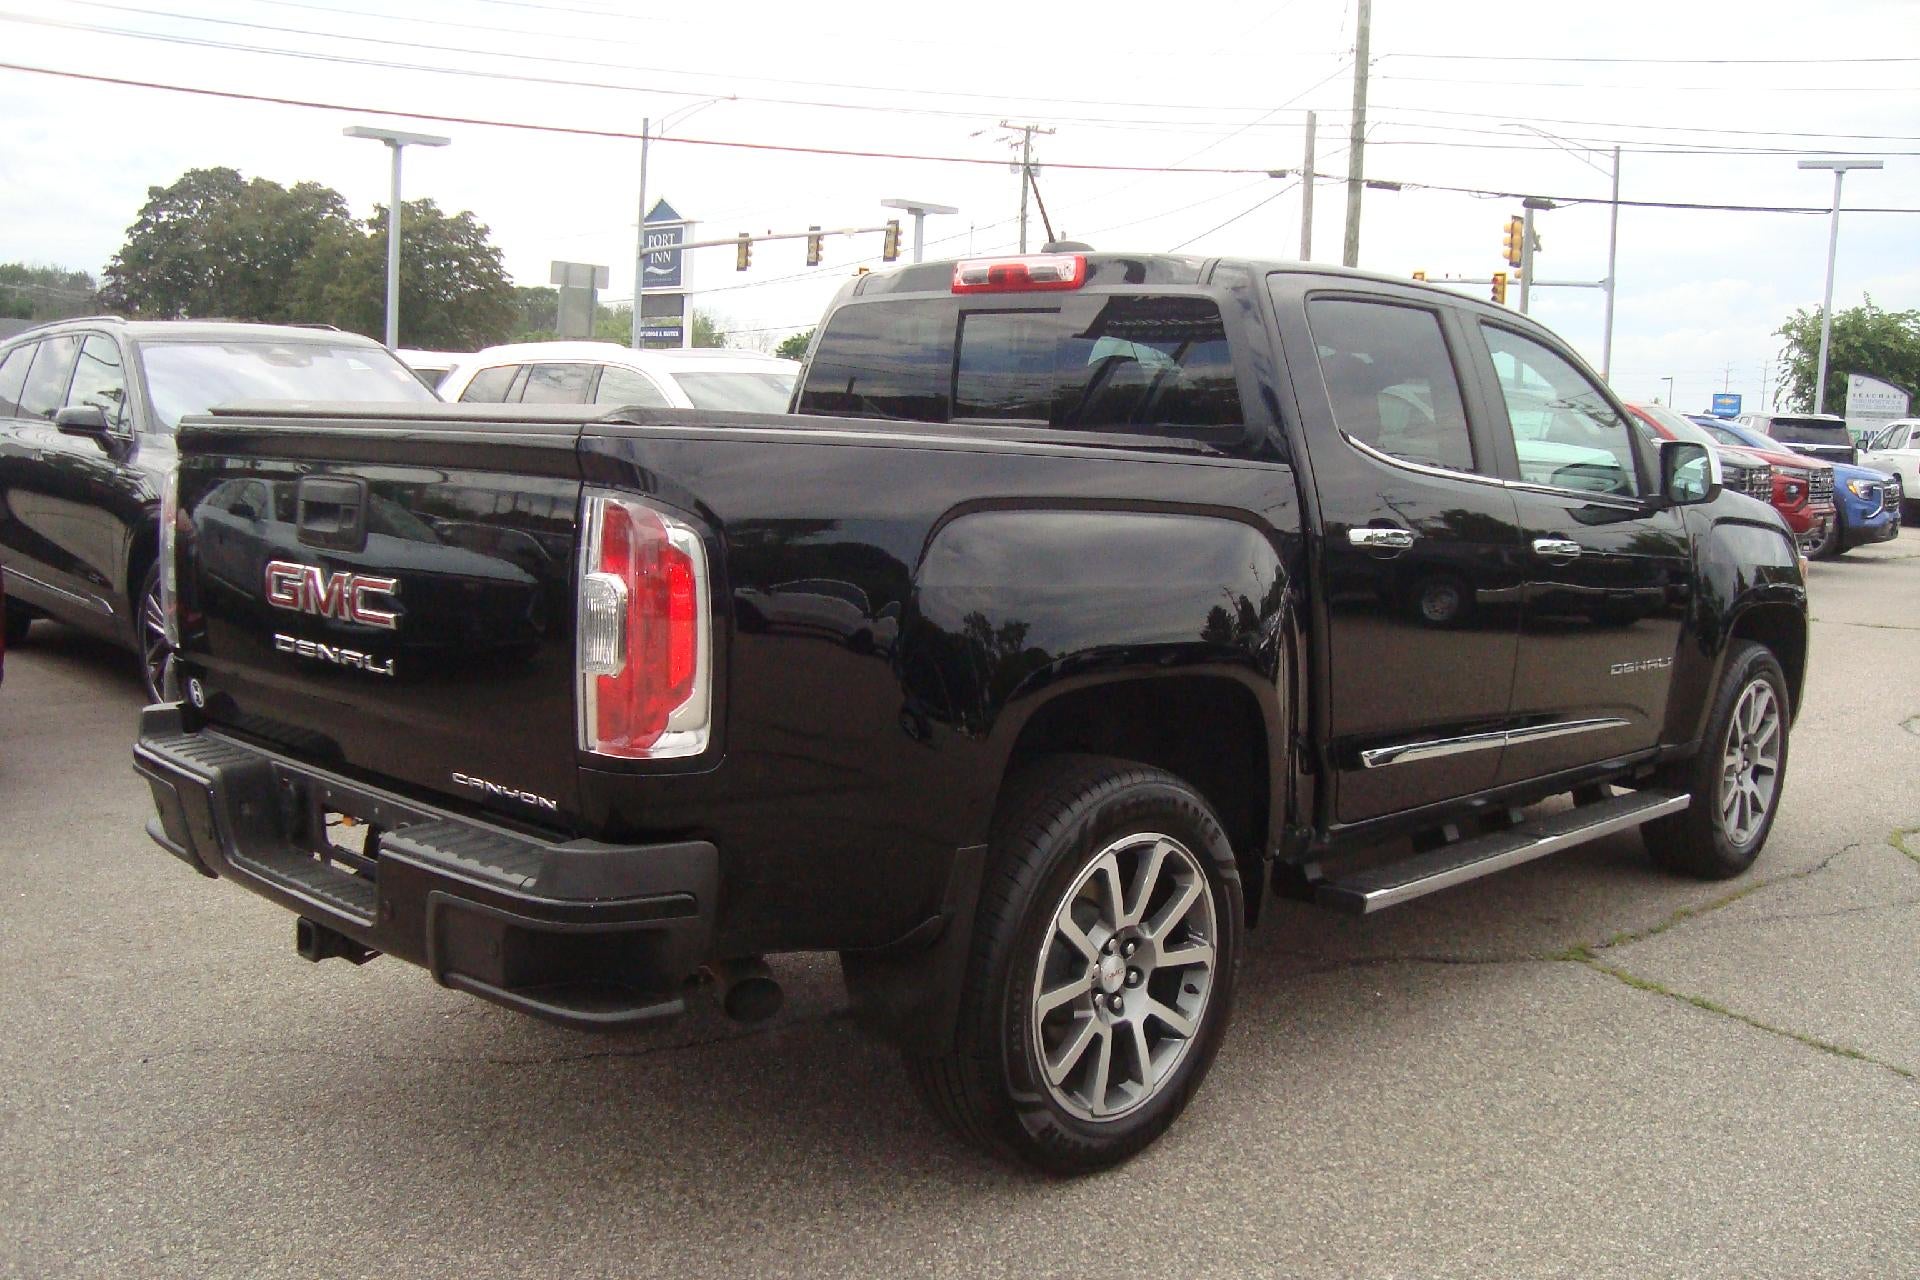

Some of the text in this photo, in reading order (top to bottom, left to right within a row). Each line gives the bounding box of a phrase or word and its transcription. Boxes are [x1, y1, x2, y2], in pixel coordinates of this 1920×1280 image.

[649, 233, 675, 247] PORT
[651, 251, 671, 263] INN
[265, 560, 398, 630] GMC
[273, 632, 395, 677] DENALI
[1610, 656, 1672, 676] DENALI
[451, 771, 558, 812] CANYON
